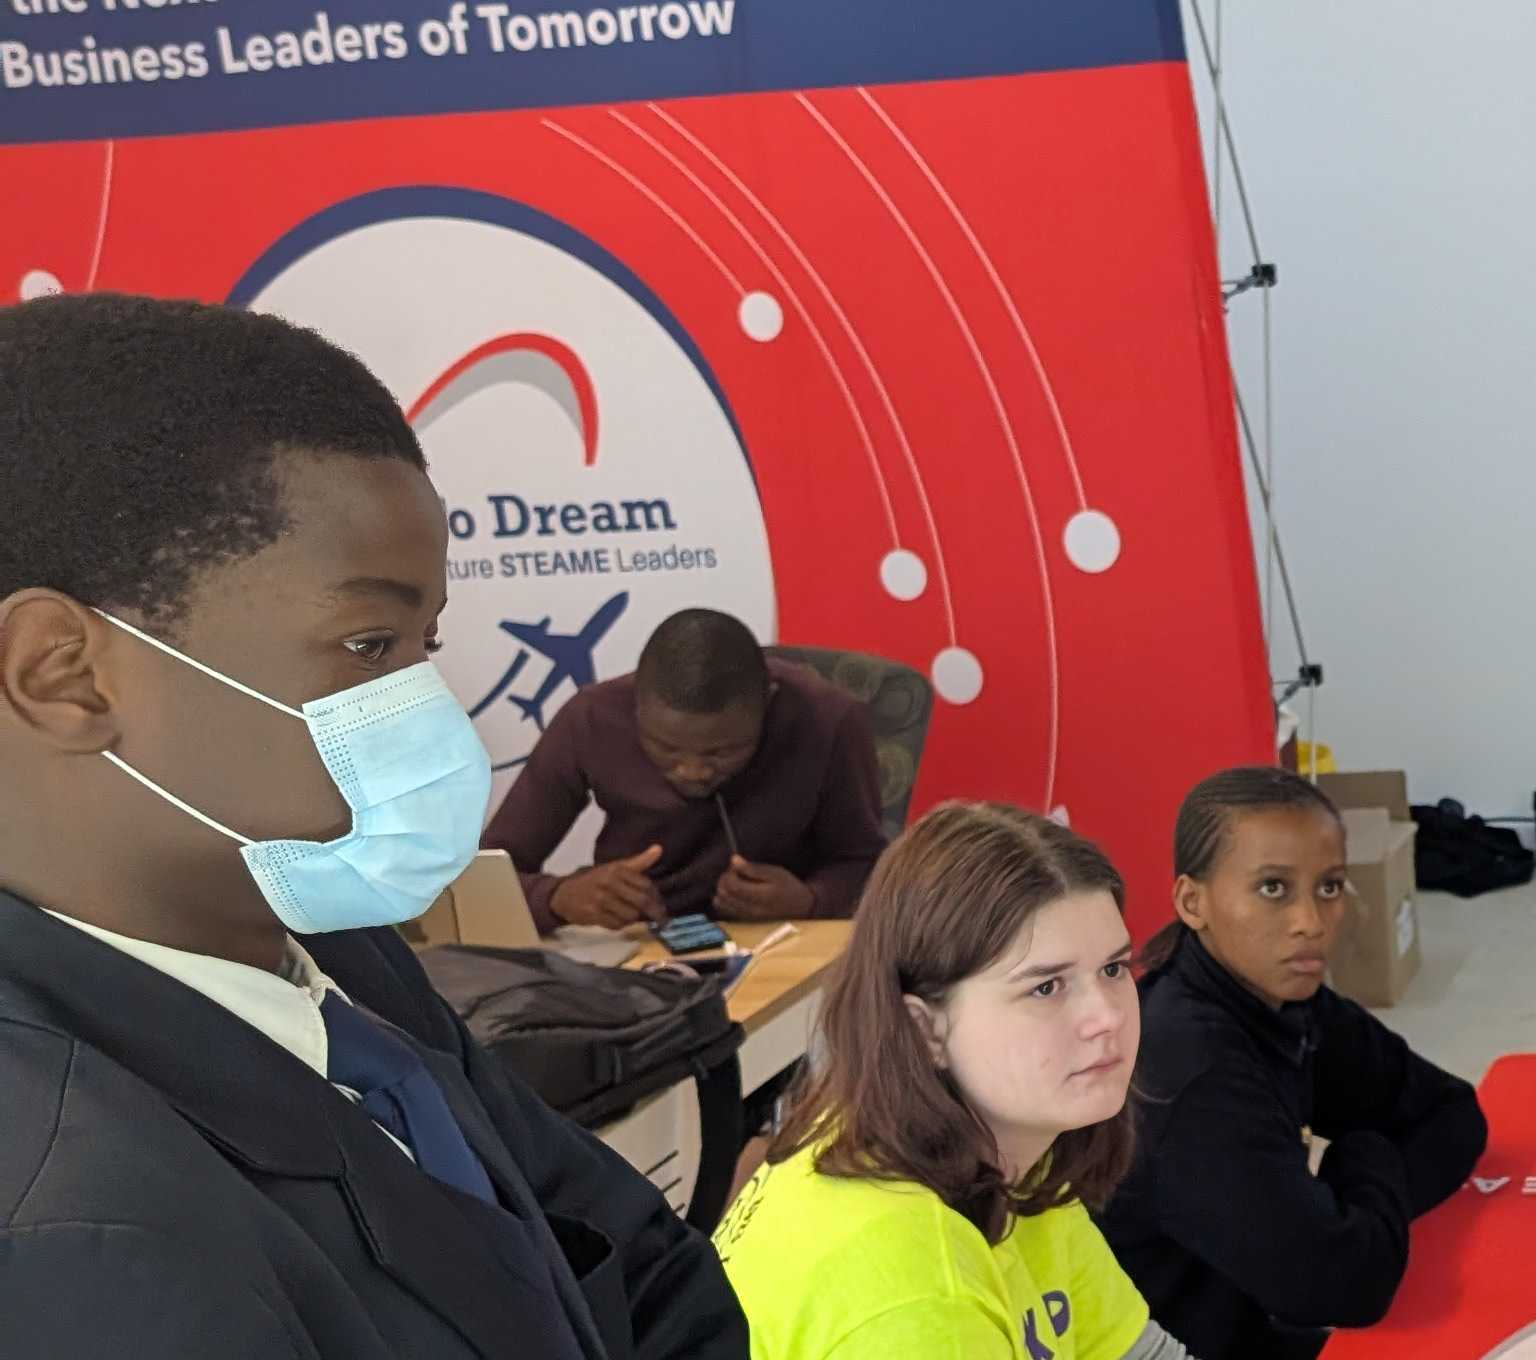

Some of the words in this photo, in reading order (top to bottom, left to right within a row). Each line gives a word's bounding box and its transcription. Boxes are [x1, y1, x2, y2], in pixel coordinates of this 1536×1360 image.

[0, 35, 209, 89] Business
[217, 11, 409, 75] Leaders
[418, 0, 469, 57] of
[441, 497, 476, 540] o
[487, 494, 677, 539] Dream
[447, 557, 494, 580] ture
[500, 547, 611, 578] STEAME
[615, 543, 718, 574] Leaders
